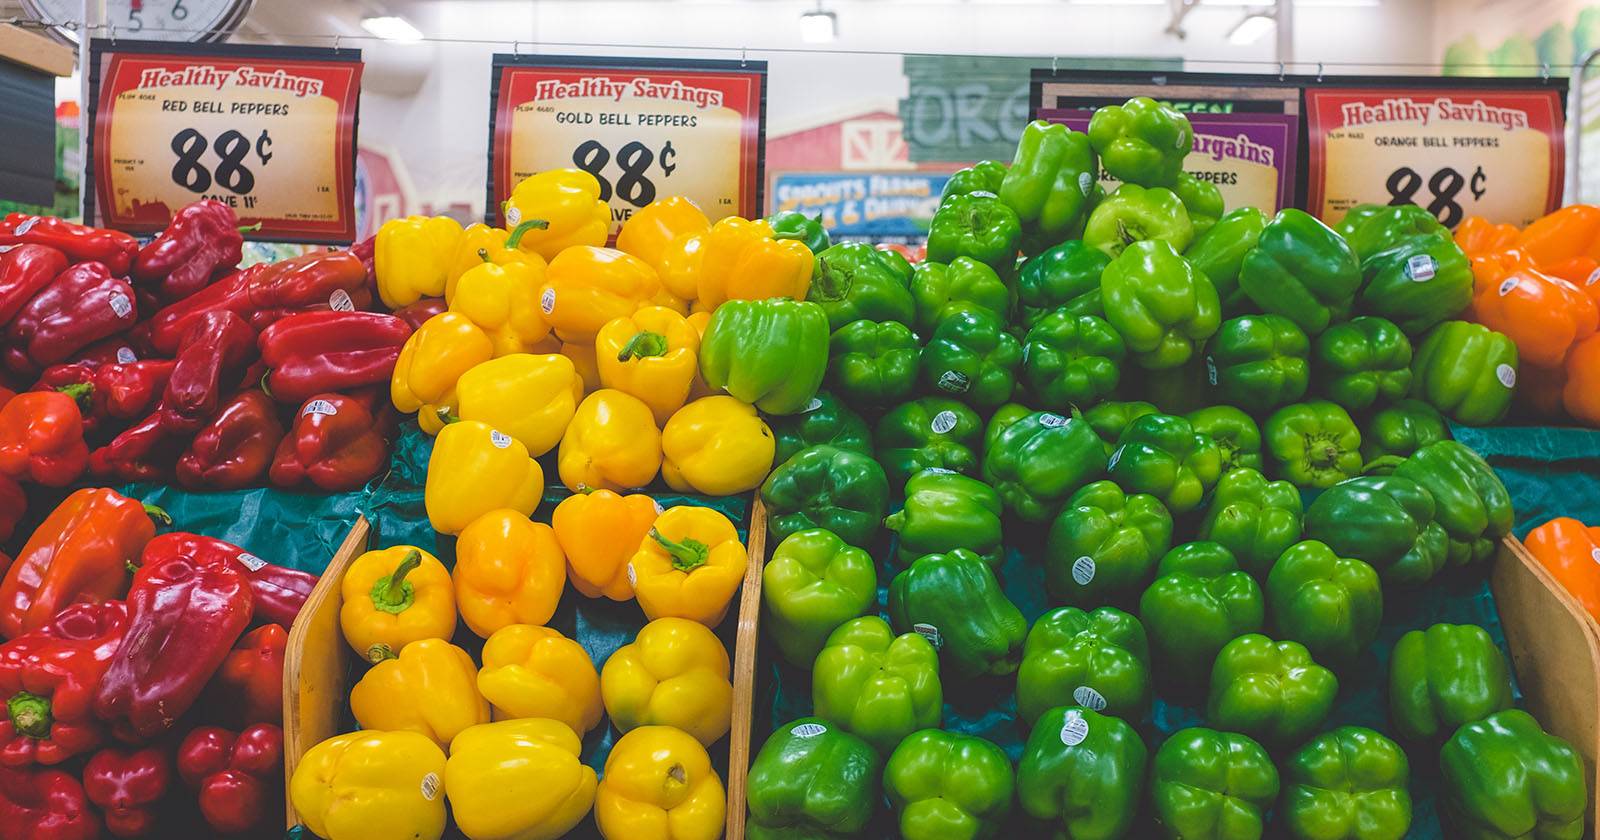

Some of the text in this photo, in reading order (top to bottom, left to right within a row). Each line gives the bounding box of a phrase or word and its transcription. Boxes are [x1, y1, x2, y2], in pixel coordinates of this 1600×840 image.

[140, 66, 321, 97] Healthy Savings
[537, 78, 720, 108] Healthy Savings
[162, 99, 289, 116] RED BELL PEPPERS
[556, 112, 698, 128] GOLD BELL PEPPERS
[1344, 100, 1524, 130] Healthy Savings
[1192, 135, 1273, 166] argains
[1374, 136, 1499, 148] ORANGE BELL PEPPERS
